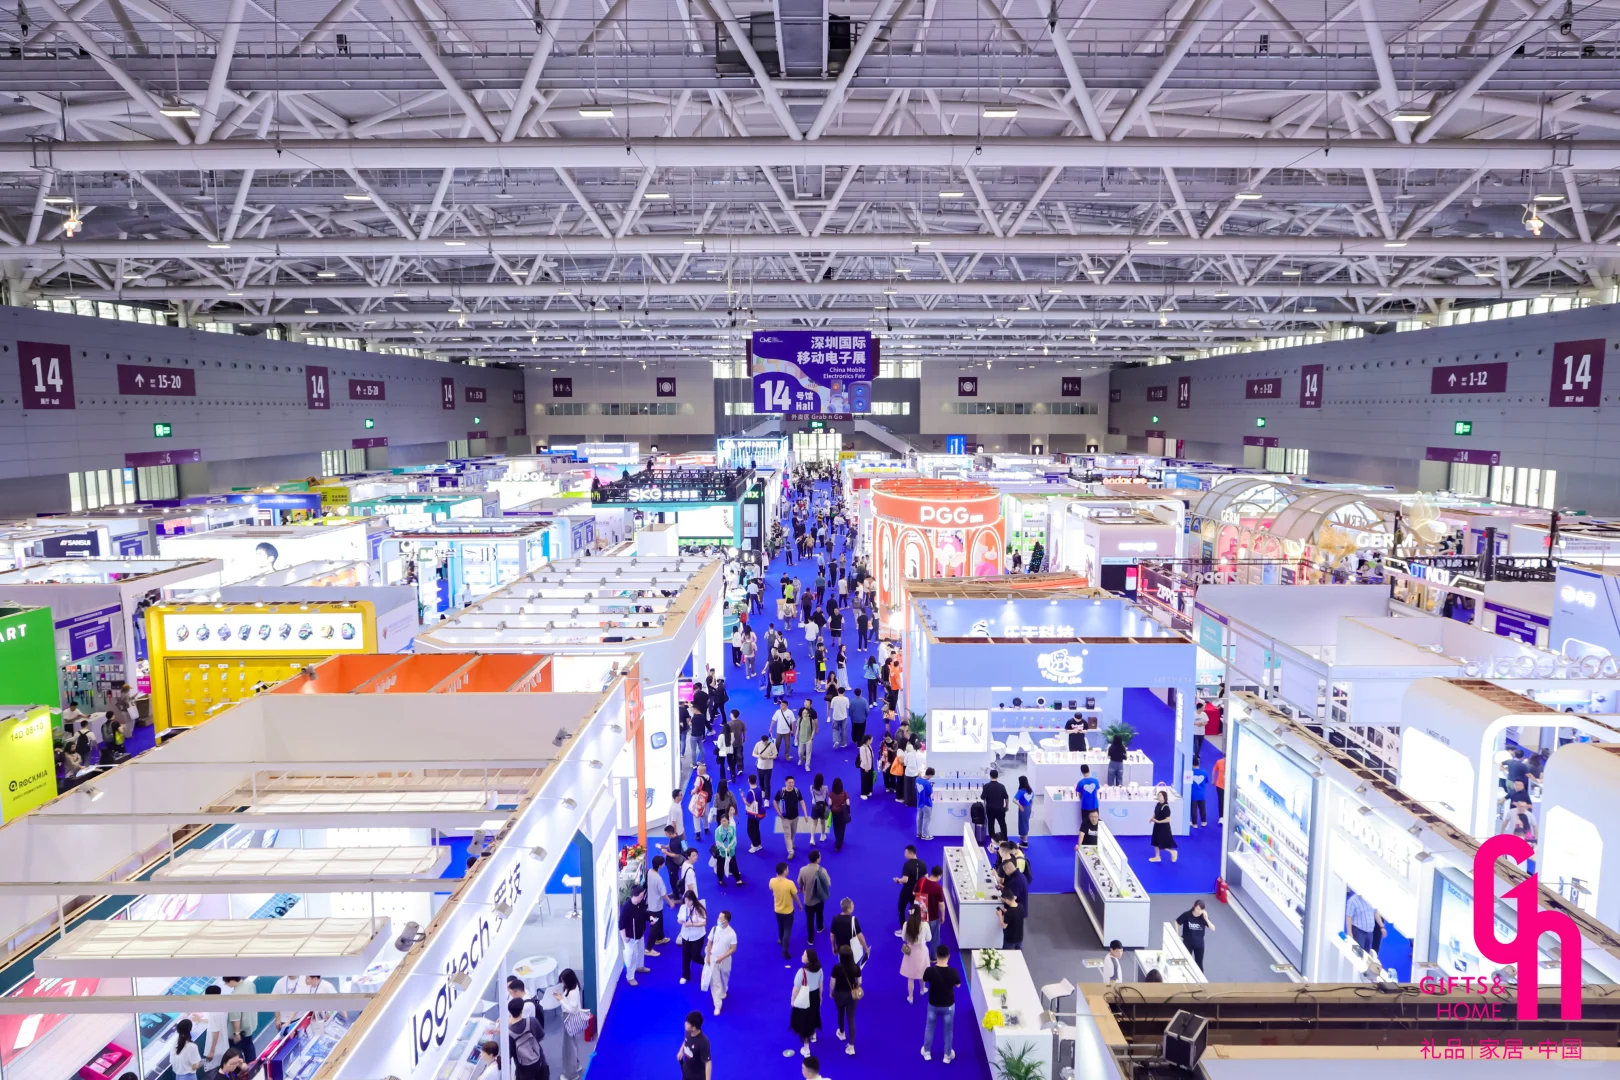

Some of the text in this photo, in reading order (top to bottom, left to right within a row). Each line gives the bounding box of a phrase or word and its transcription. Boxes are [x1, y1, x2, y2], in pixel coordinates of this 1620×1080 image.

[811, 336, 866, 350] 深圳国际
[797, 351, 866, 364] 移动电子展
[32, 356, 63, 392] 14
[1469, 371, 1488, 386] 1-12
[1562, 354, 1592, 390] 14
[158, 374, 182, 389] 15-20
[311, 376, 325, 398] 14
[1304, 374, 1318, 397] 14
[444, 384, 453, 402] 14
[760, 380, 792, 410] 14
[796, 392, 814, 400] 号馆
[1180, 383, 1188, 401] 14
[796, 402, 814, 410] Hall
[166, 453, 171, 463] 6
[1460, 452, 1468, 462] 14
[628, 488, 662, 500] SKG
[1221, 509, 1240, 525] GERM
